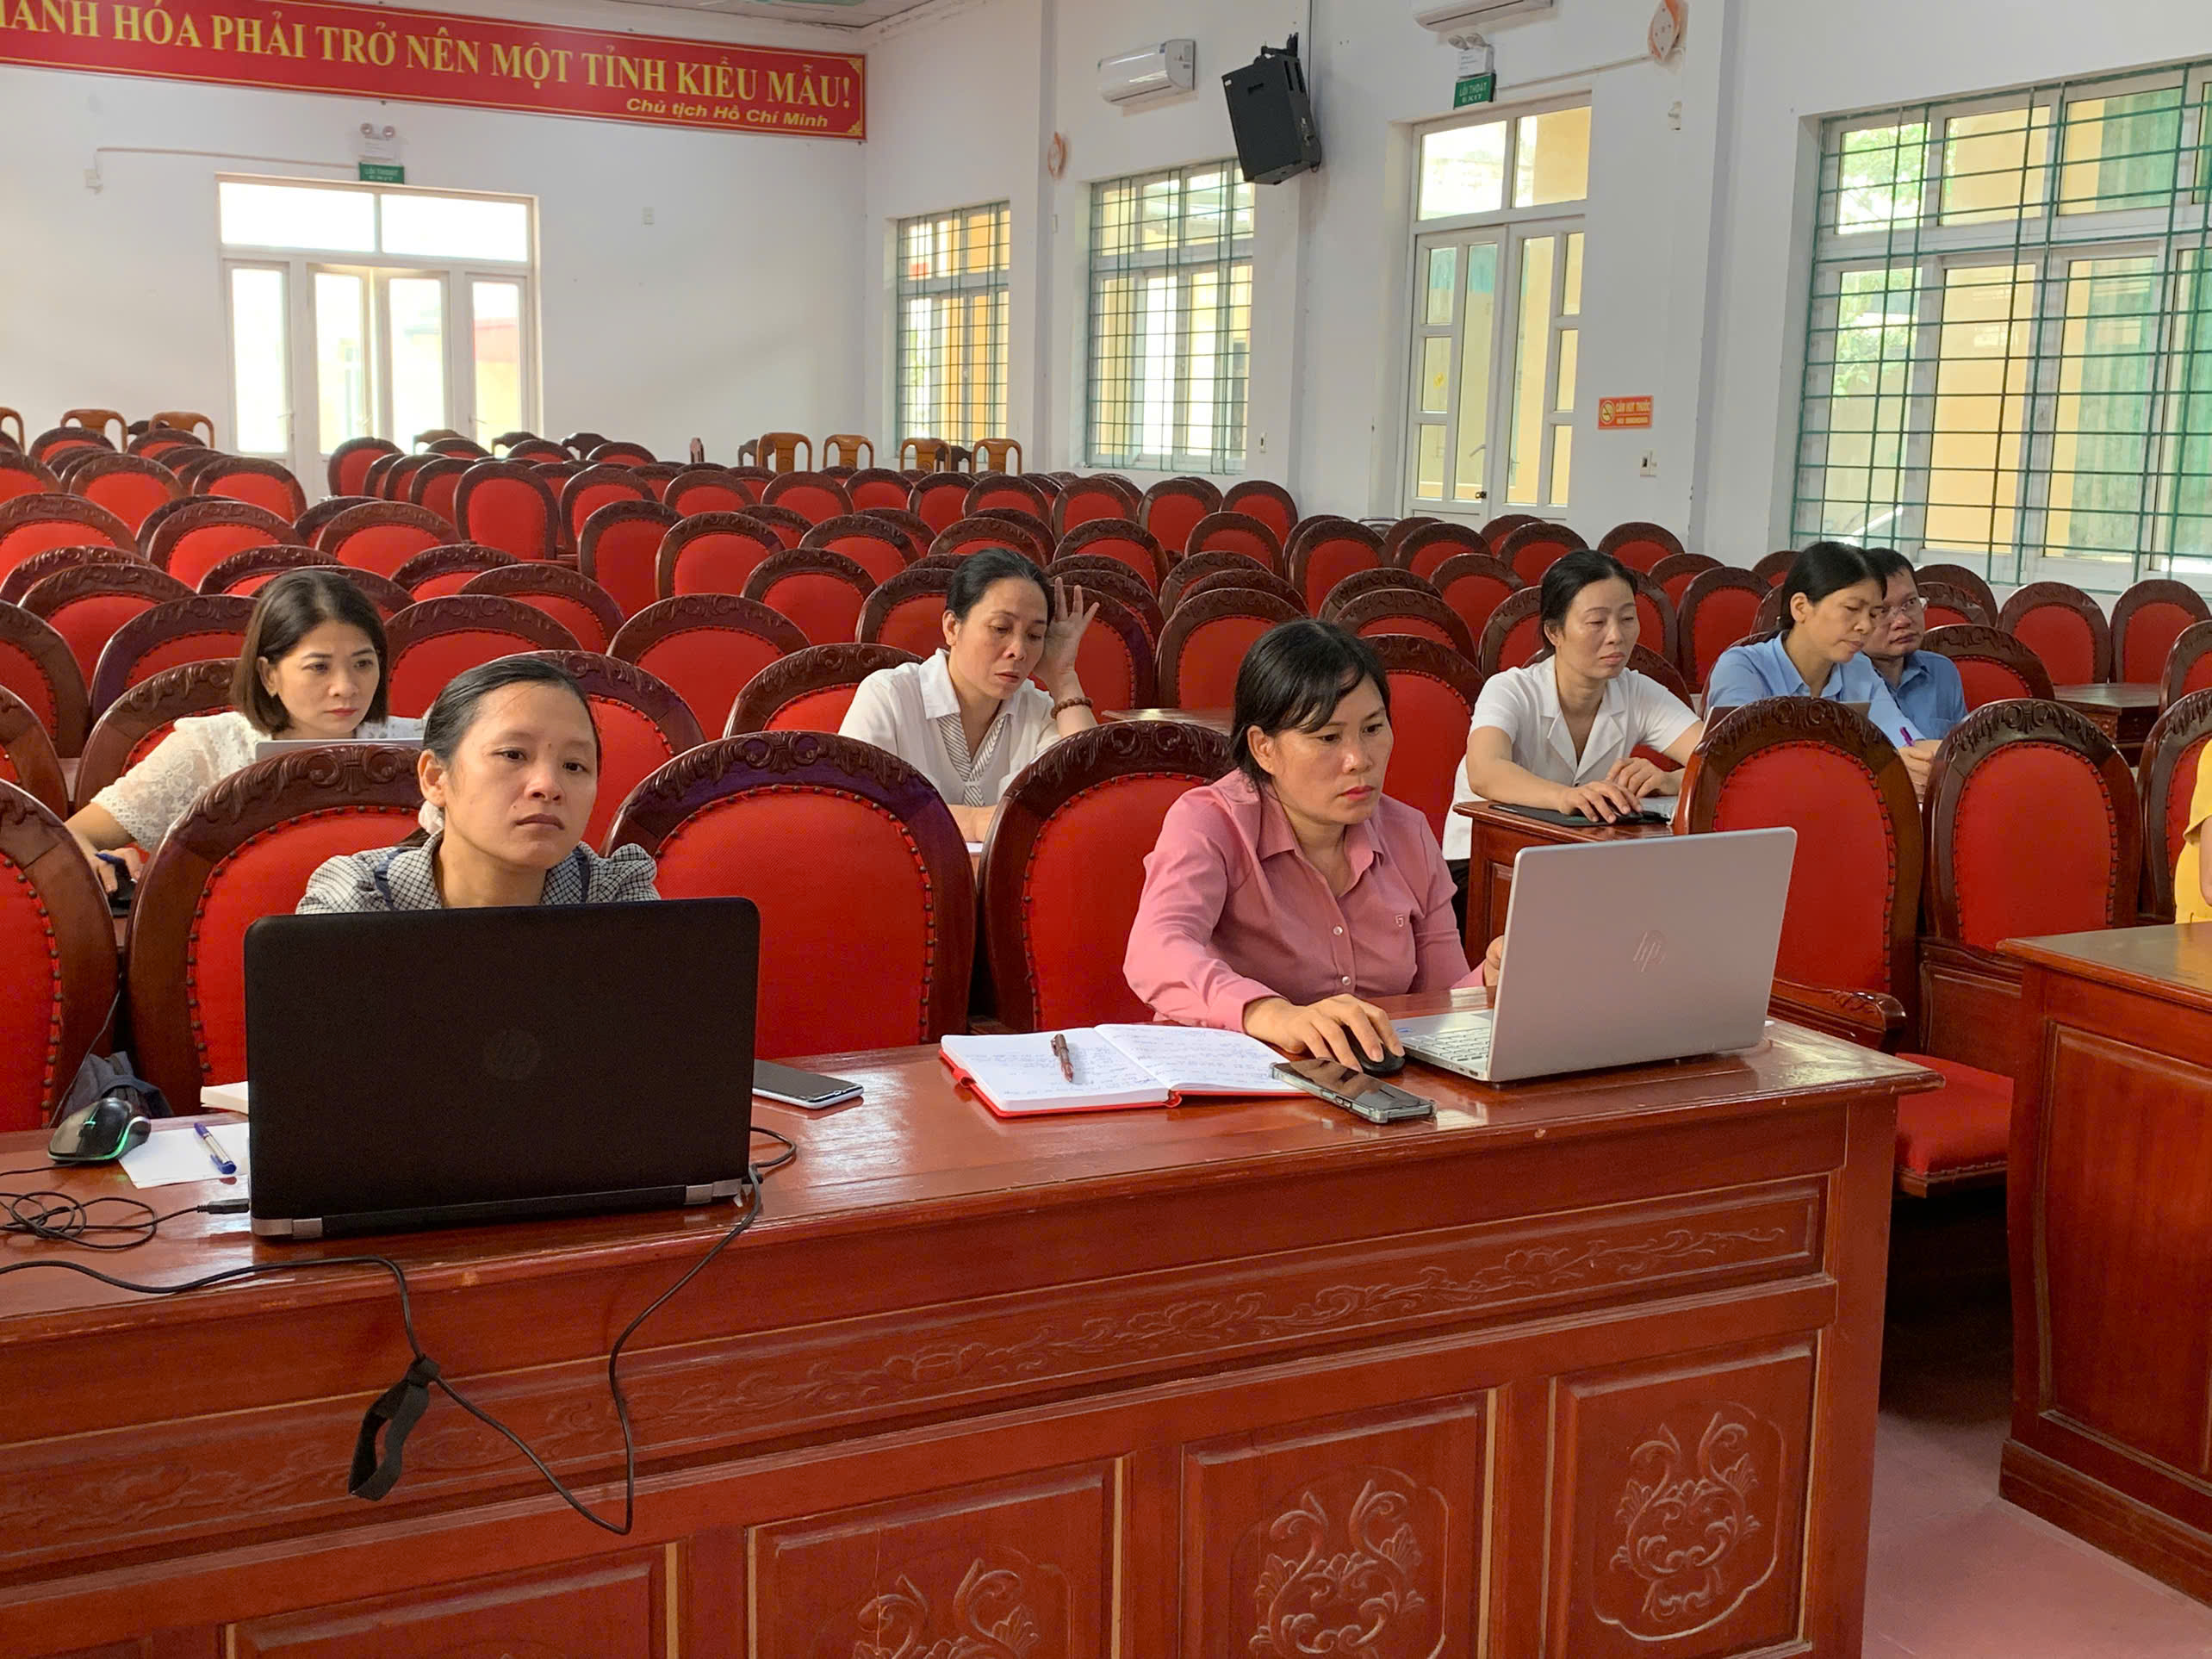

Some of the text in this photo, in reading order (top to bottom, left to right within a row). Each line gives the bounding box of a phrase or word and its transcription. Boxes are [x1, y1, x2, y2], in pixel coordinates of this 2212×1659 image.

[0, 0, 101, 37] ANH
[112, 0, 203, 47] HÓA
[210, 10, 307, 59] PHẢI
[315, 21, 396, 66] TRỞ
[405, 27, 481, 74] NÊN
[490, 41, 573, 89] MỘT
[581, 45, 668, 92] TỈNH
[767, 64, 850, 109] MẪU!
[626, 97, 828, 127] Chủ tịch Hồ Chí Minh
